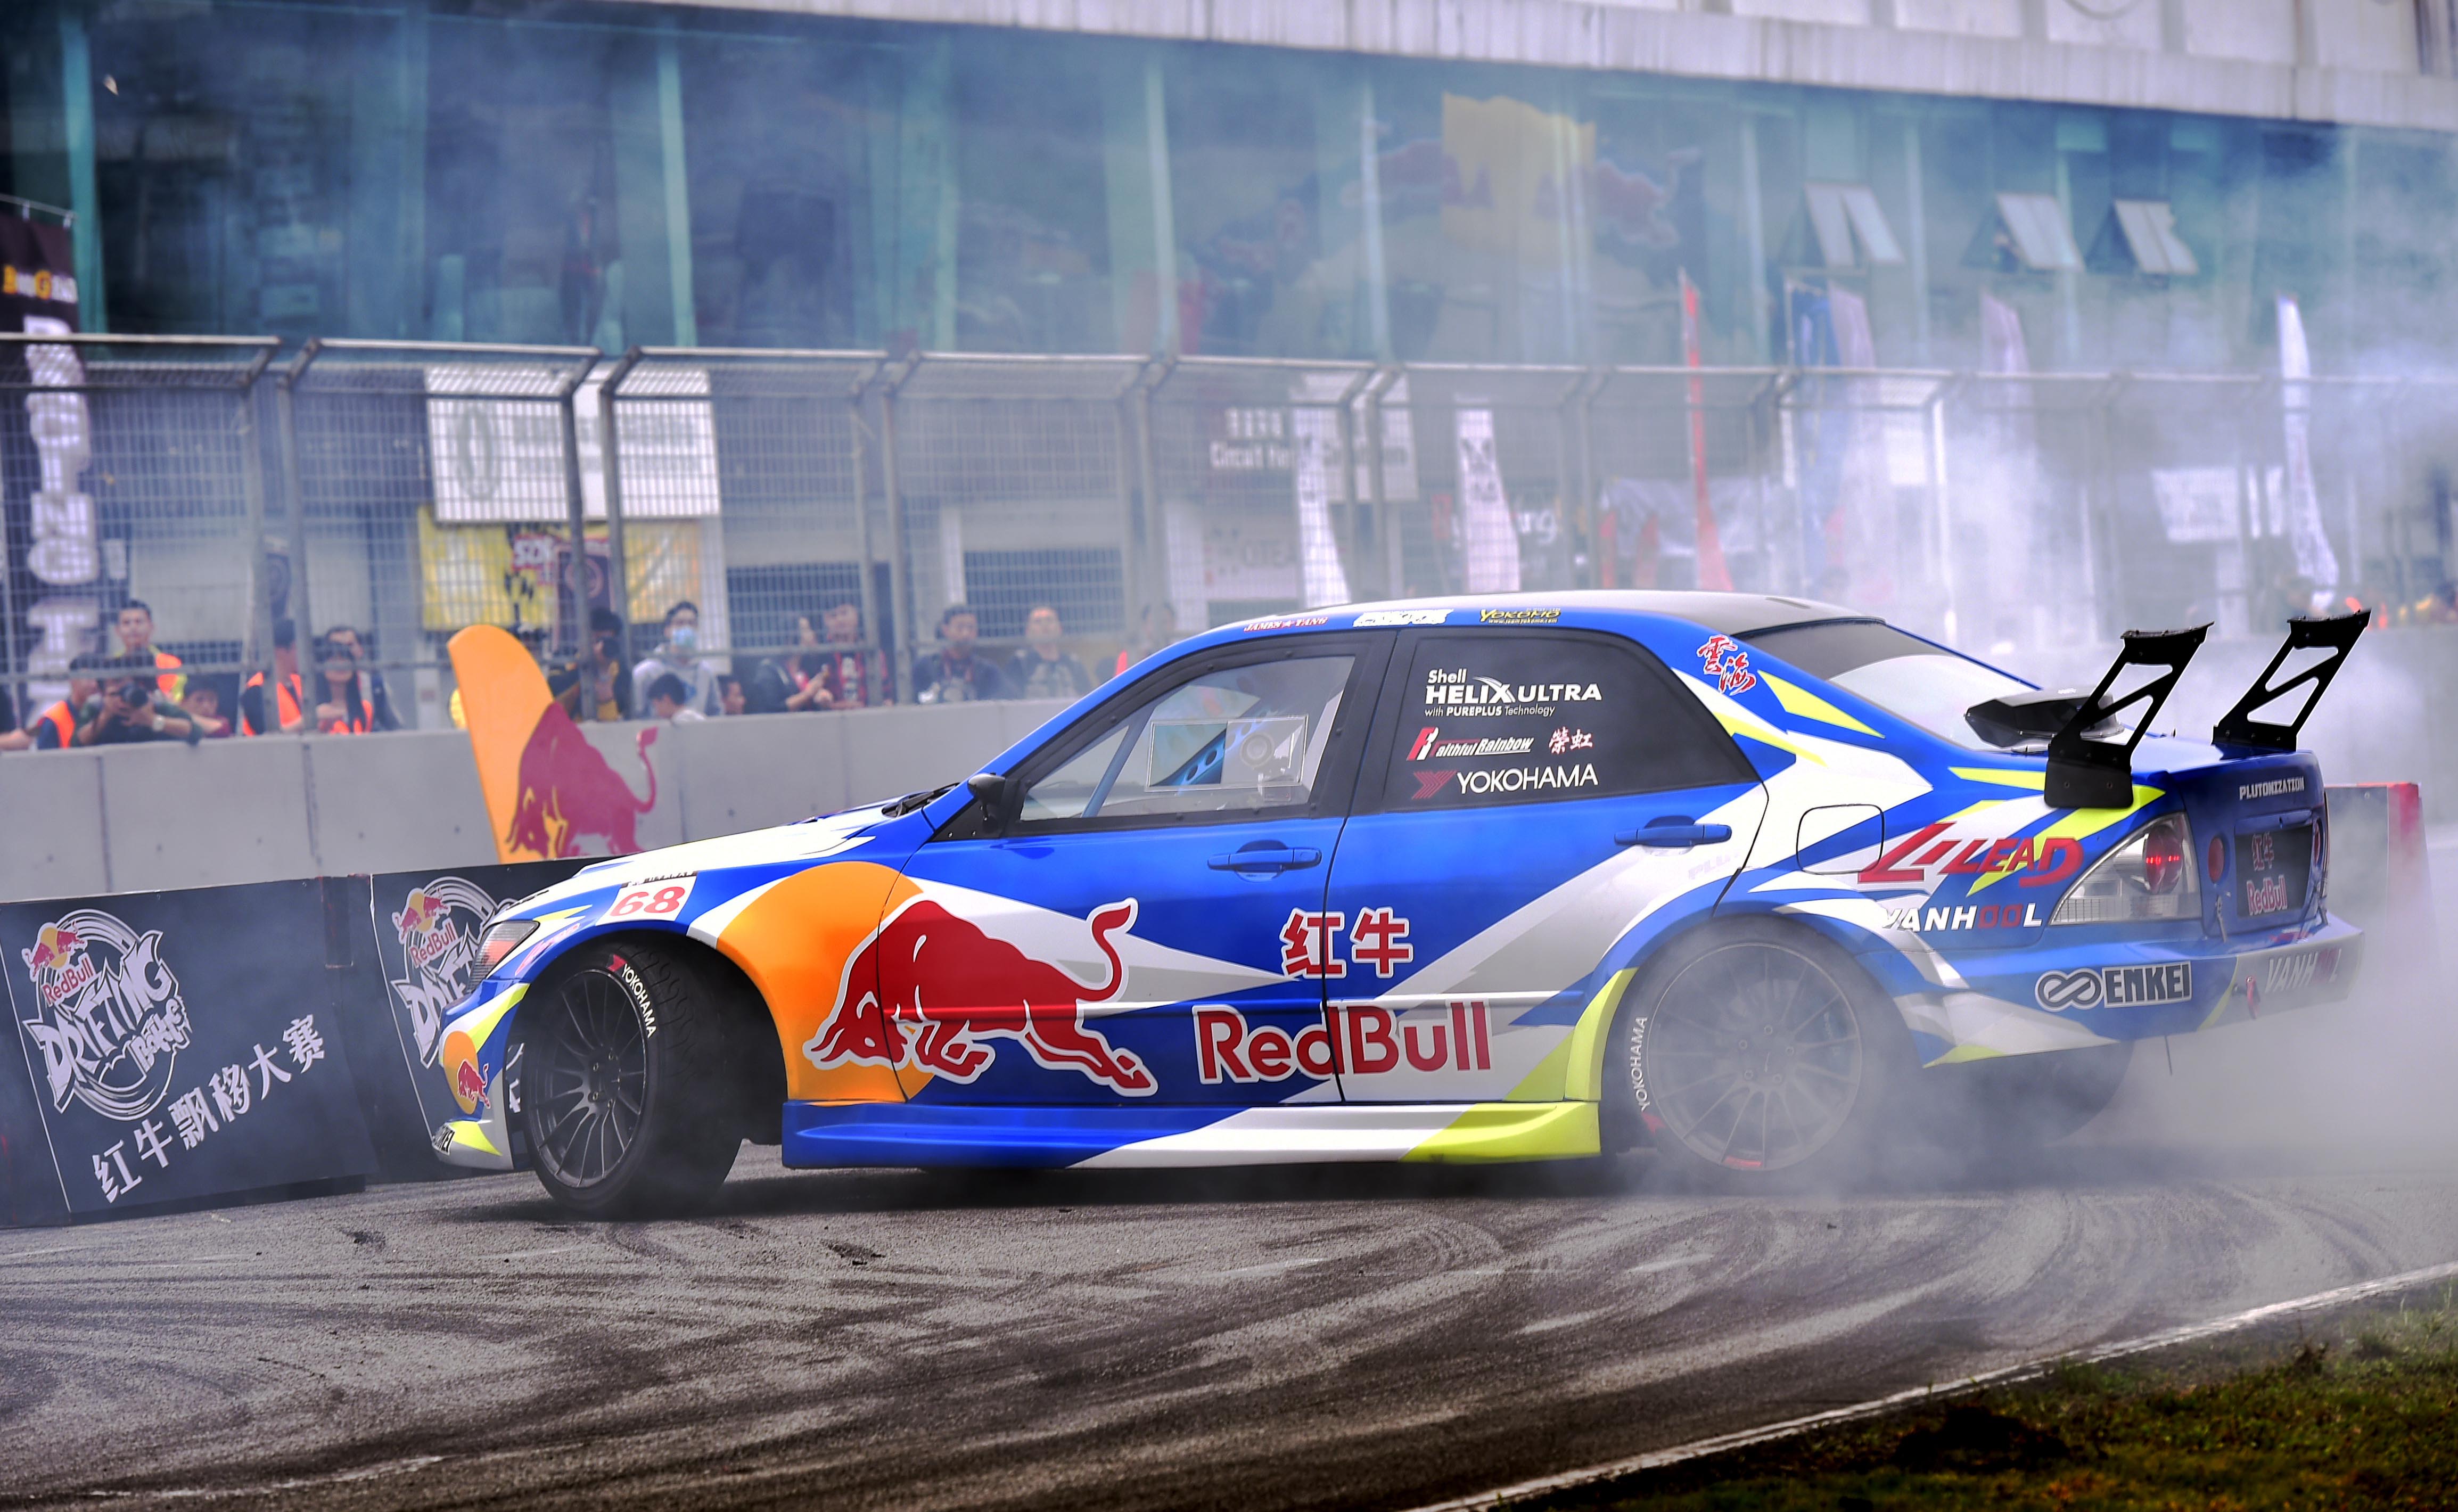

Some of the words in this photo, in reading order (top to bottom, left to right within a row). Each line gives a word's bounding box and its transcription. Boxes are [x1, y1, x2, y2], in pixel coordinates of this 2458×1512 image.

[1425, 679, 1516, 704] HELIX
[1517, 683, 1602, 703] ULTRA
[1428, 669, 1467, 684] Shell
[1425, 706, 1444, 717] with
[1446, 705, 1502, 717] PUREPLUS
[1505, 704, 1556, 718] Technology
[1457, 763, 1598, 794] YOKOHAMA
[2239, 776, 2305, 800] PLUTONIZATION
[2251, 832, 2274, 871] 红牛
[610, 886, 685, 916] 68
[2246, 874, 2288, 916] RedBull
[1881, 902, 2043, 932] VANHOOL
[409, 923, 458, 966] RedBull
[1280, 907, 1413, 979] 红牛
[42, 957, 95, 1006] RedBull
[621, 963, 656, 1039] YOKOHAMA
[2103, 962, 2190, 1007] ENKEI
[28, 934, 174, 1105] DRIFTING
[1193, 1000, 1492, 1083] RedBull
[1630, 1016, 1650, 1112] YOKOHAMA
[92, 1013, 325, 1204] 红牛飘移大赛
